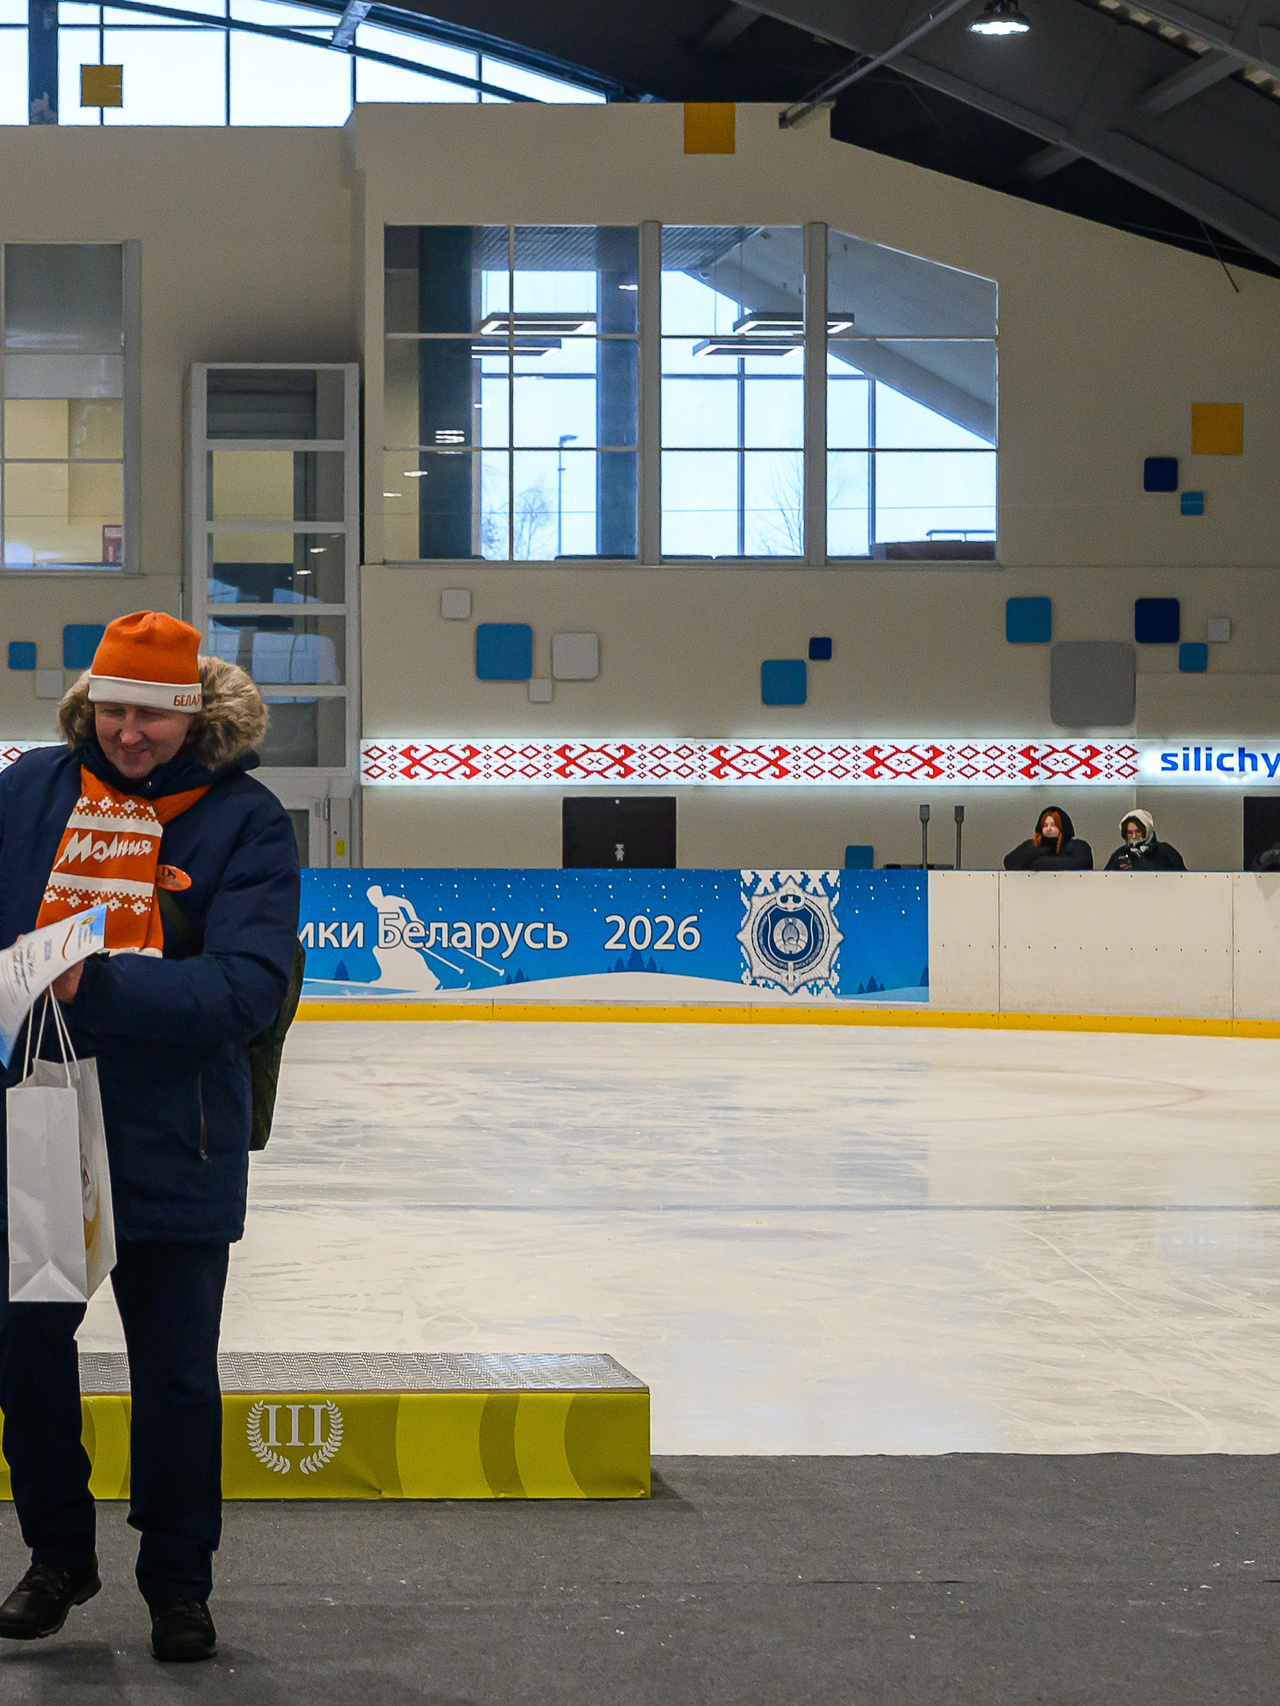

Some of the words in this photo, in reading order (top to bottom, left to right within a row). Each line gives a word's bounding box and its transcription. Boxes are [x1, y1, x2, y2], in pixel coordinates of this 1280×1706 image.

[1160, 746, 1280, 778] silichy
[377, 911, 569, 959] Беларусь
[604, 914, 701, 951] 2026
[263, 1404, 327, 1446] III
